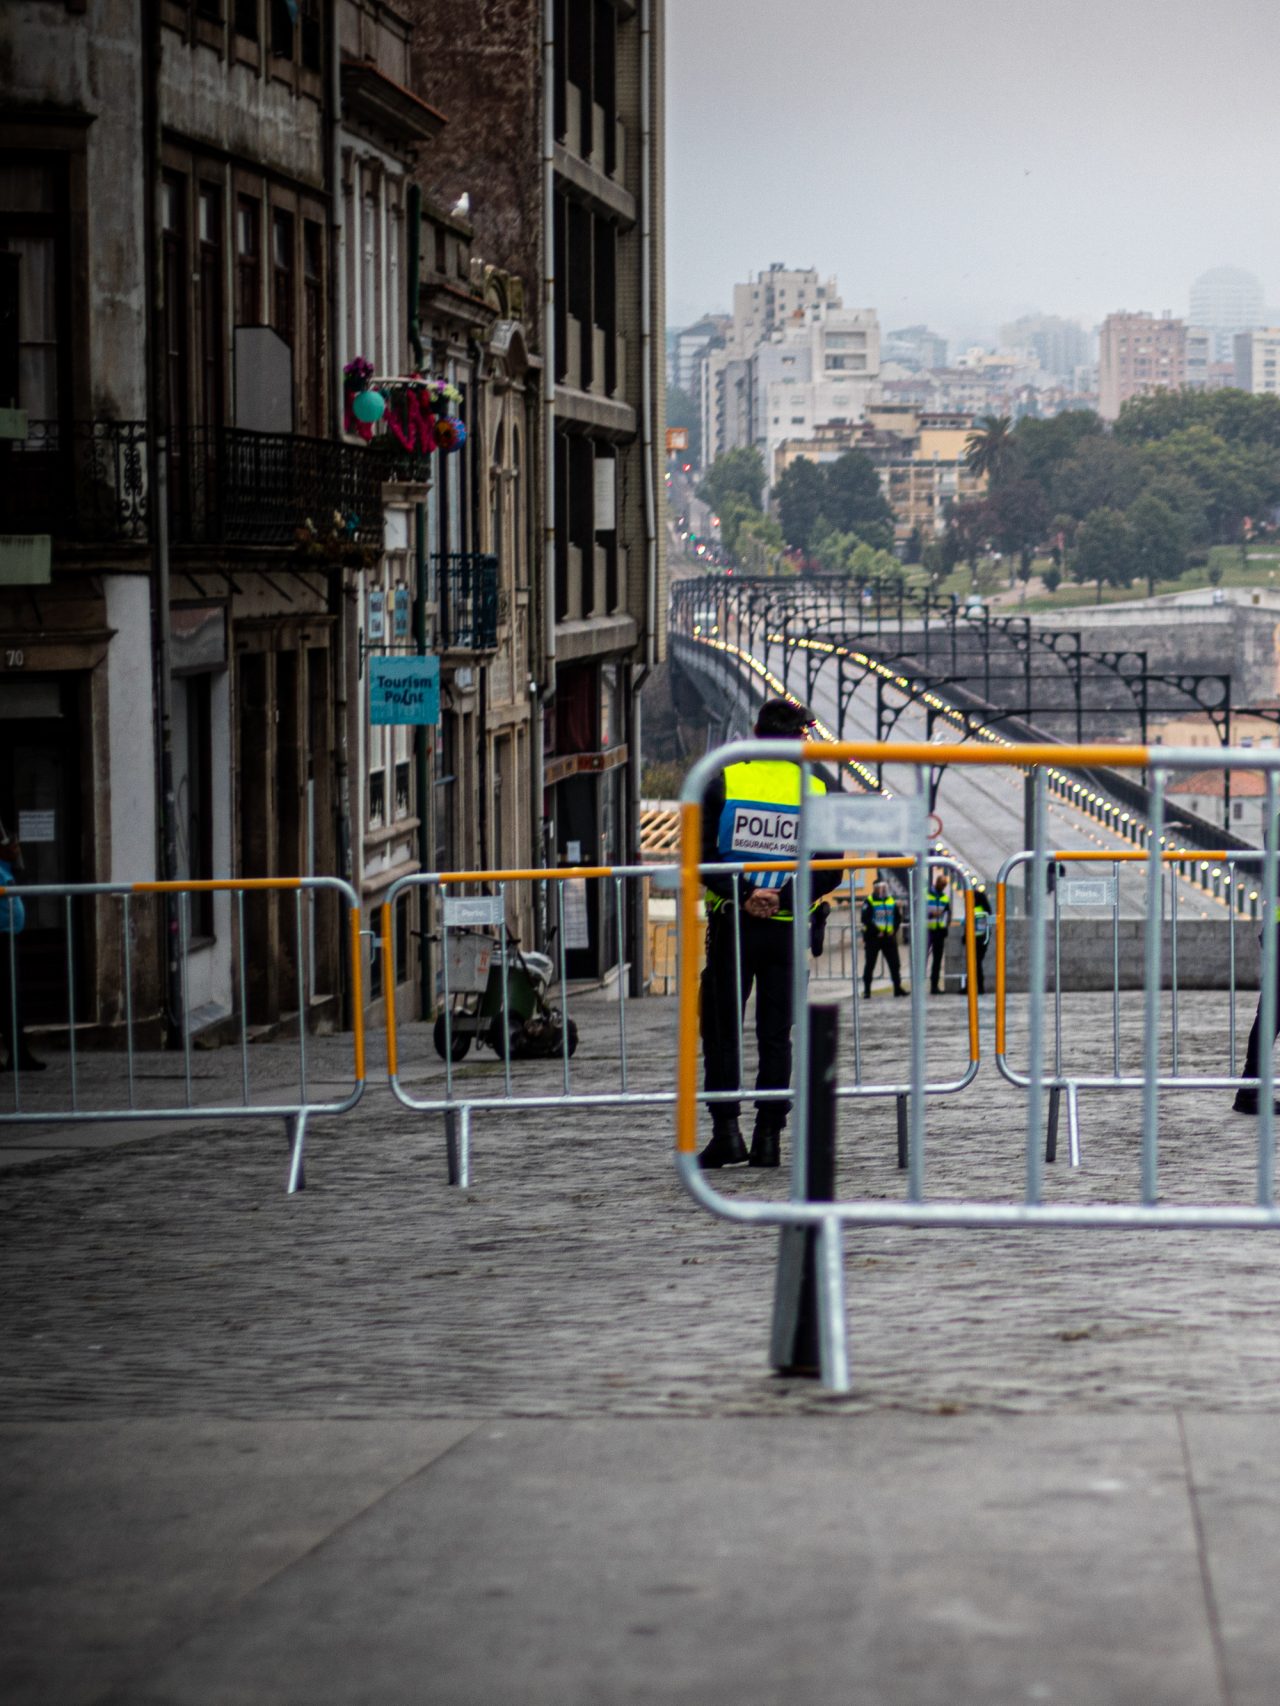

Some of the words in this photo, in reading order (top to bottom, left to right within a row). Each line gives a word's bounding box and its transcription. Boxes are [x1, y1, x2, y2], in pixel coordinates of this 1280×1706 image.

[6, 650, 24, 666] 70
[377, 675, 432, 688] Tourism
[384, 689, 424, 706] Point
[735, 814, 799, 841] POLÍCI
